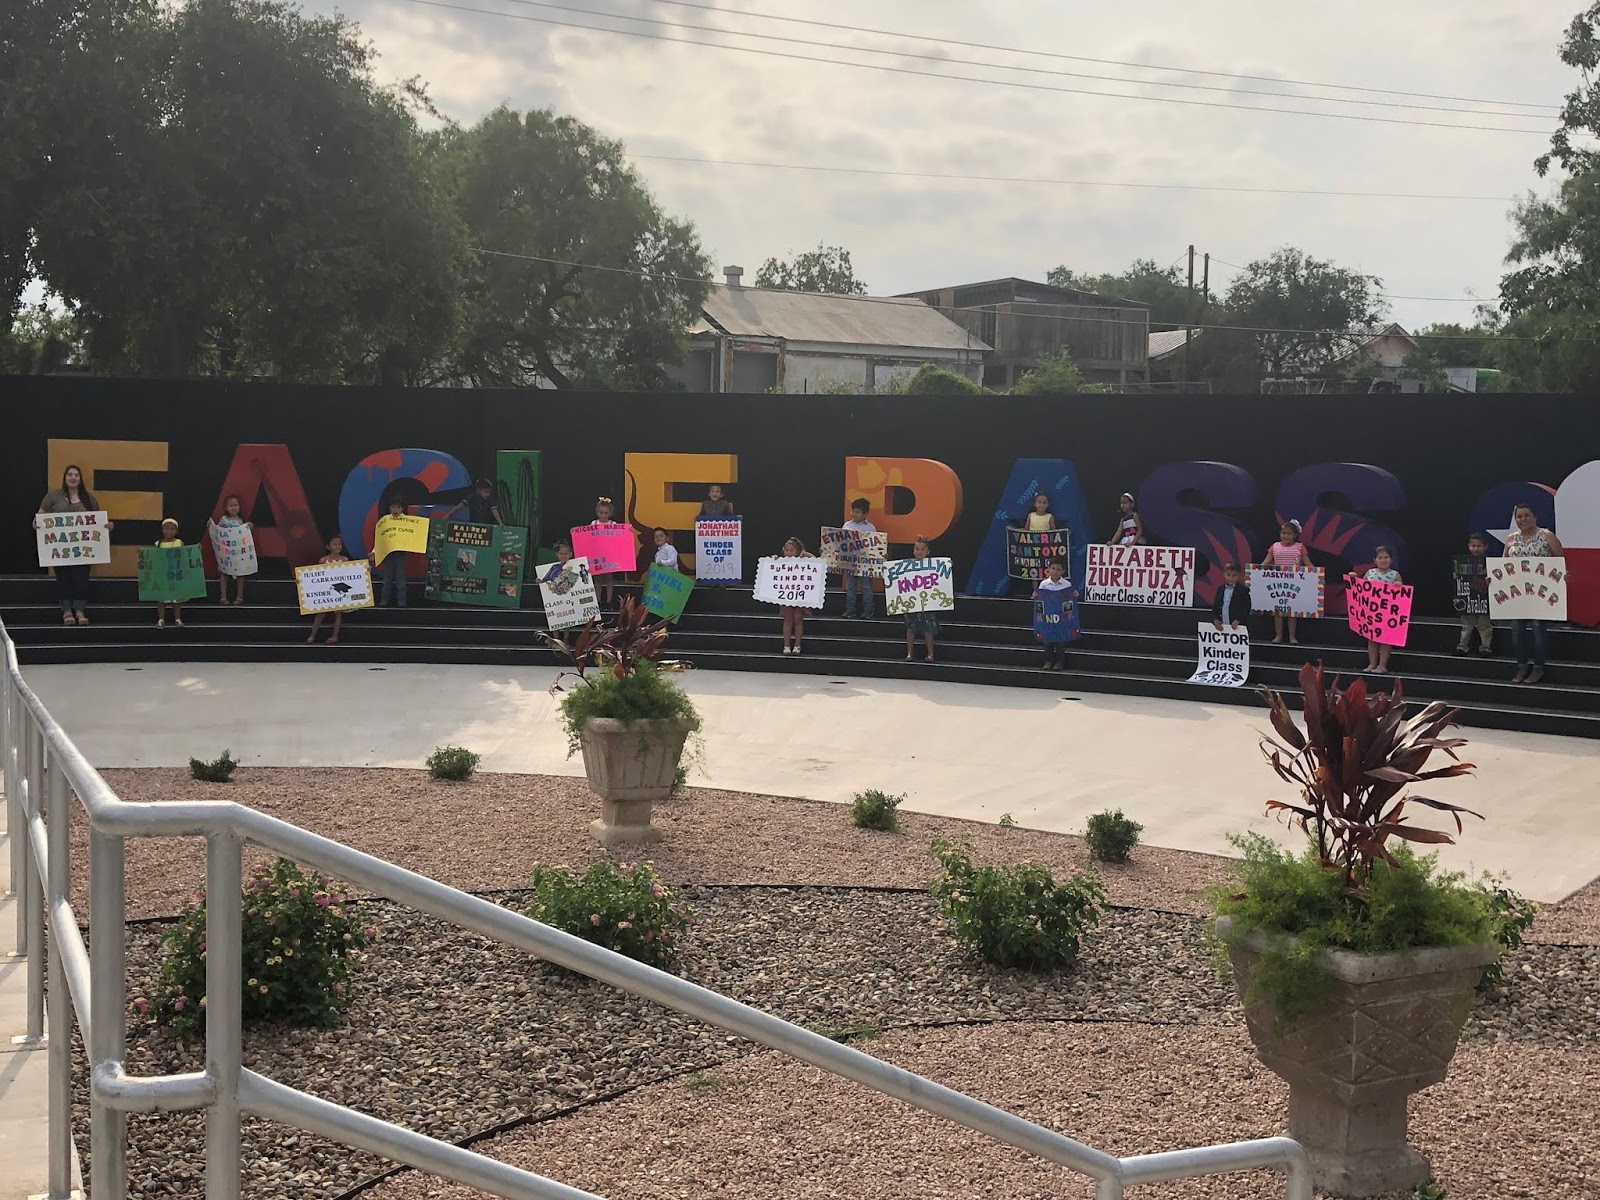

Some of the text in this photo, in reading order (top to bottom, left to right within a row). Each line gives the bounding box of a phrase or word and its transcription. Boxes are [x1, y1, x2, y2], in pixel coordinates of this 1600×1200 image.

[43, 514, 97, 530] DREAM
[697, 522, 740, 530] JONATHAN
[44, 530, 102, 545] MAKER
[697, 529, 740, 537] MARTINEZ
[821, 530, 860, 545] ETHAN
[703, 541, 735, 549] KINDER
[840, 535, 882, 553] GARCIA
[1010, 544, 1067, 557] SANTOYO
[51, 545, 96, 560] ASST.
[1089, 546, 1194, 569] ELIZABETH
[705, 562, 734, 575] 2019
[769, 563, 818, 574] SUEHAYLA
[1014, 557, 1041, 568] CLASS
[303, 570, 326, 578] JULIET
[772, 574, 813, 582] KINDER
[1088, 566, 1185, 590] ZURUTUZA
[1262, 571, 1295, 579] JASLYNN
[1491, 559, 1563, 584] DREAM
[311, 574, 362, 584] CARRASQUILLO
[897, 572, 940, 594] KINDER
[305, 590, 332, 598] KINDER
[570, 587, 595, 597] KINDER
[1266, 582, 1301, 594] KINDER
[1345, 577, 1412, 601] BROOKLYN
[1493, 582, 1560, 607] MAKER
[313, 597, 334, 605] CLASS
[777, 590, 806, 601] 2019
[1085, 586, 1117, 602] Kinder
[1117, 588, 1145, 604] Class
[1147, 590, 1158, 604] of
[1158, 591, 1186, 606] 2019
[1270, 590, 1297, 600] CLASS
[545, 599, 564, 609] CLASS
[565, 599, 575, 607] OF
[888, 595, 917, 614] CLASS
[919, 590, 929, 612] OF
[1352, 590, 1400, 616] KINDER
[1350, 605, 1408, 629] CLASS OF
[550, 619, 577, 630] KENNEDY
[1197, 631, 1249, 645] VICTOR
[1358, 623, 1382, 640] 2019
[1203, 646, 1246, 660] Kinder
[1206, 660, 1243, 673] Class
[1211, 672, 1228, 680] of
